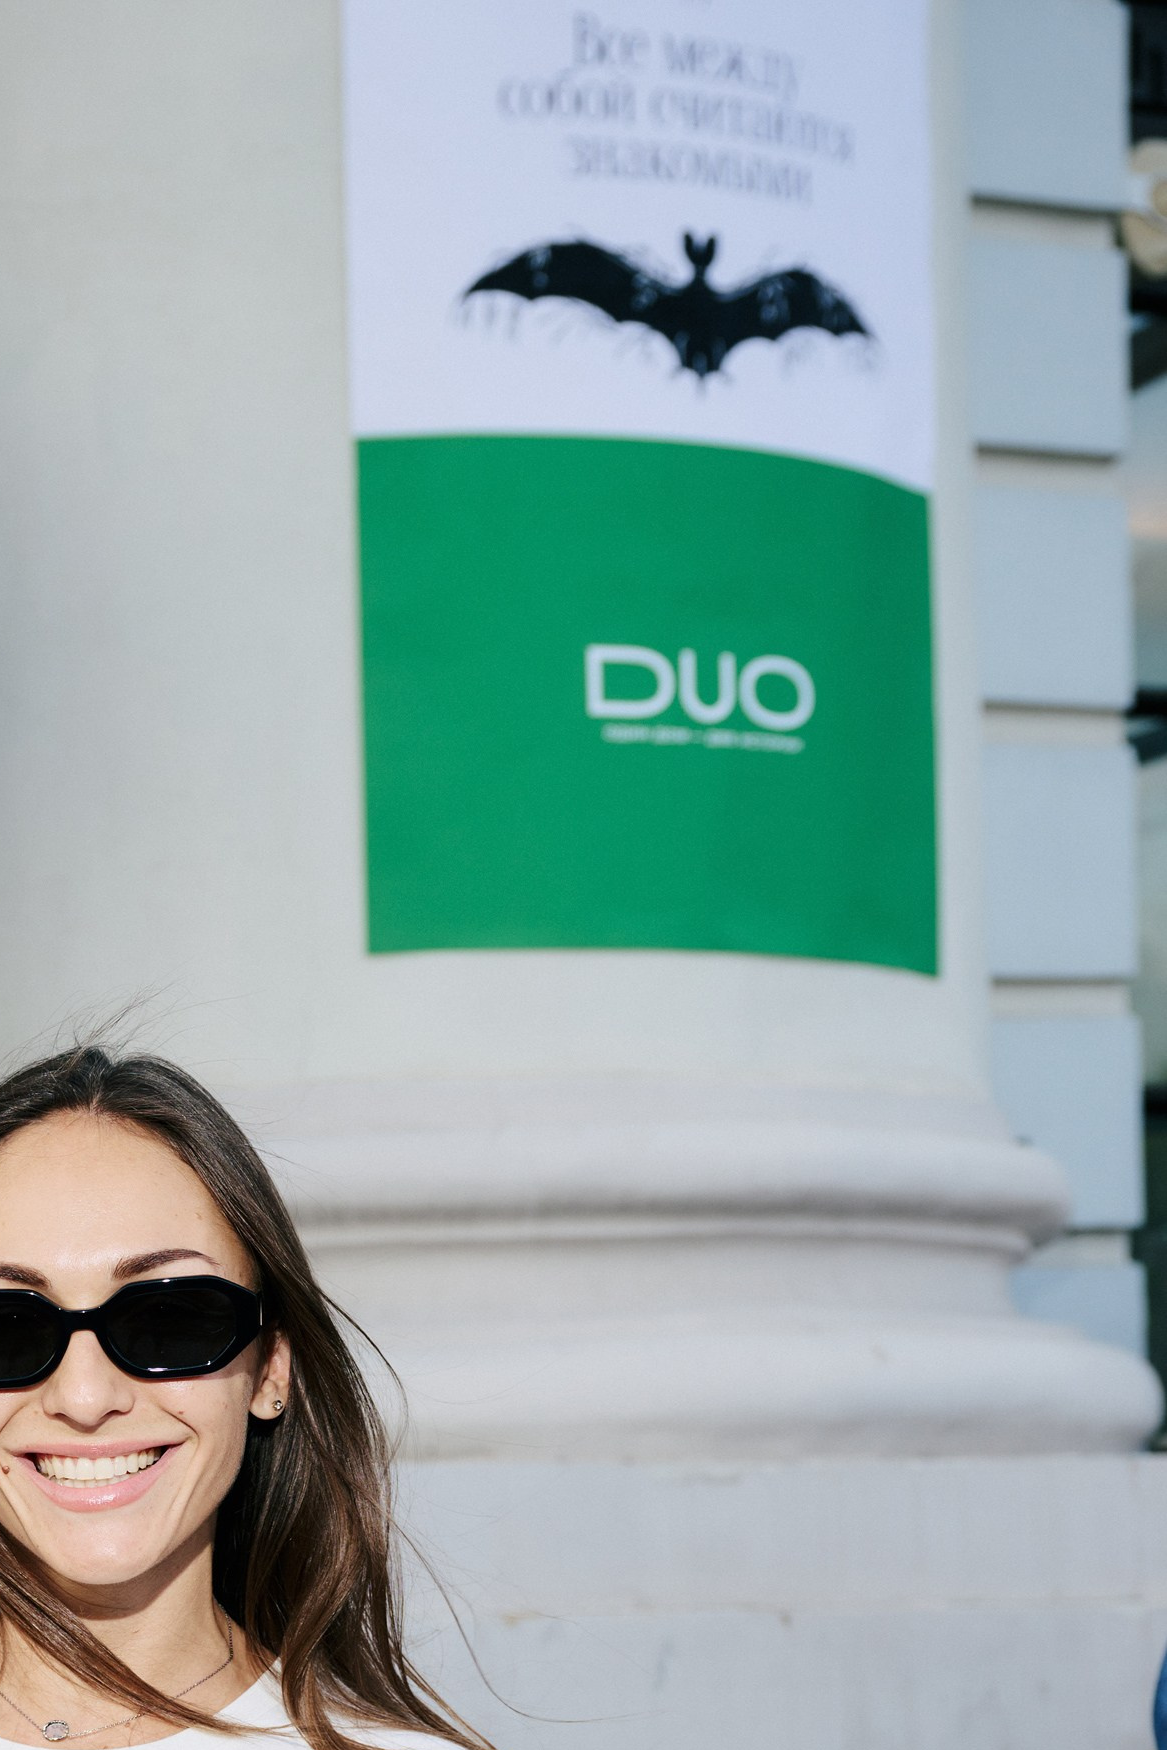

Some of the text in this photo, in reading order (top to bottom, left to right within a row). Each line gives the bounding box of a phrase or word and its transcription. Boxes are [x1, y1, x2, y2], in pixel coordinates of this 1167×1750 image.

[494, 67, 637, 125] собой
[571, 9, 803, 102] Все между
[585, 643, 816, 732] DUO
